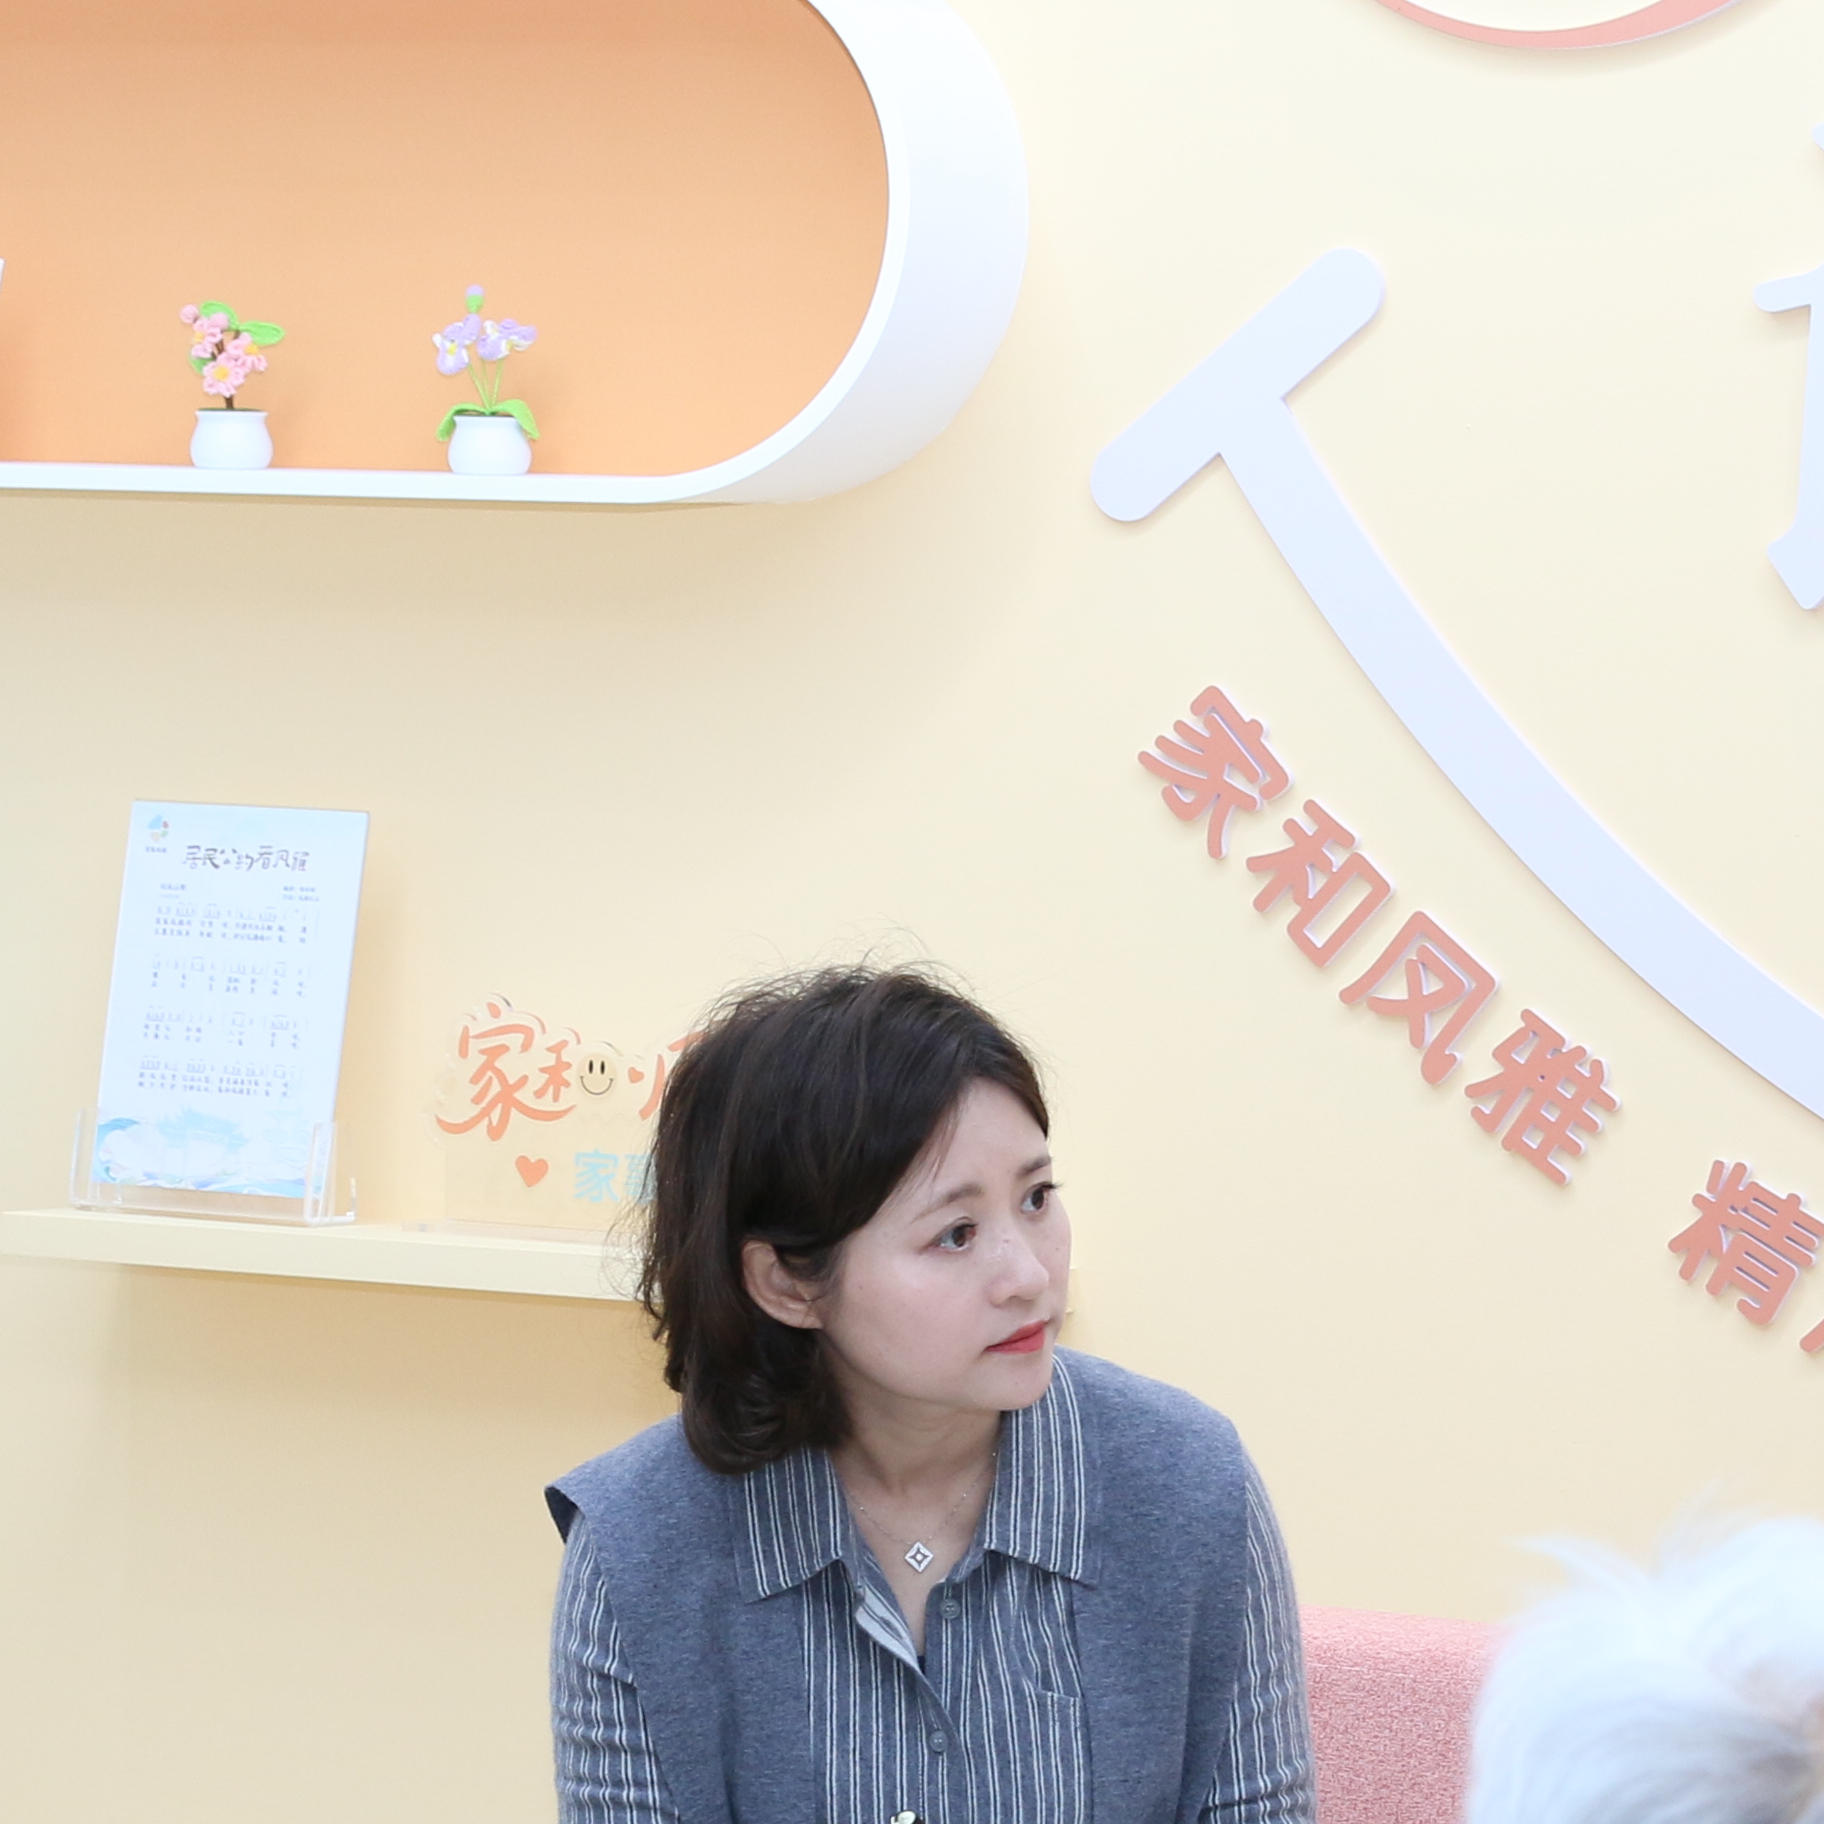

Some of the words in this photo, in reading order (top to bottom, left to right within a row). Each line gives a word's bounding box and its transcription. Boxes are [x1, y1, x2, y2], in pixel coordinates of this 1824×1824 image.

[434, 1001, 696, 1142] 家和
[1138, 685, 1622, 1186] 家和凤雅
